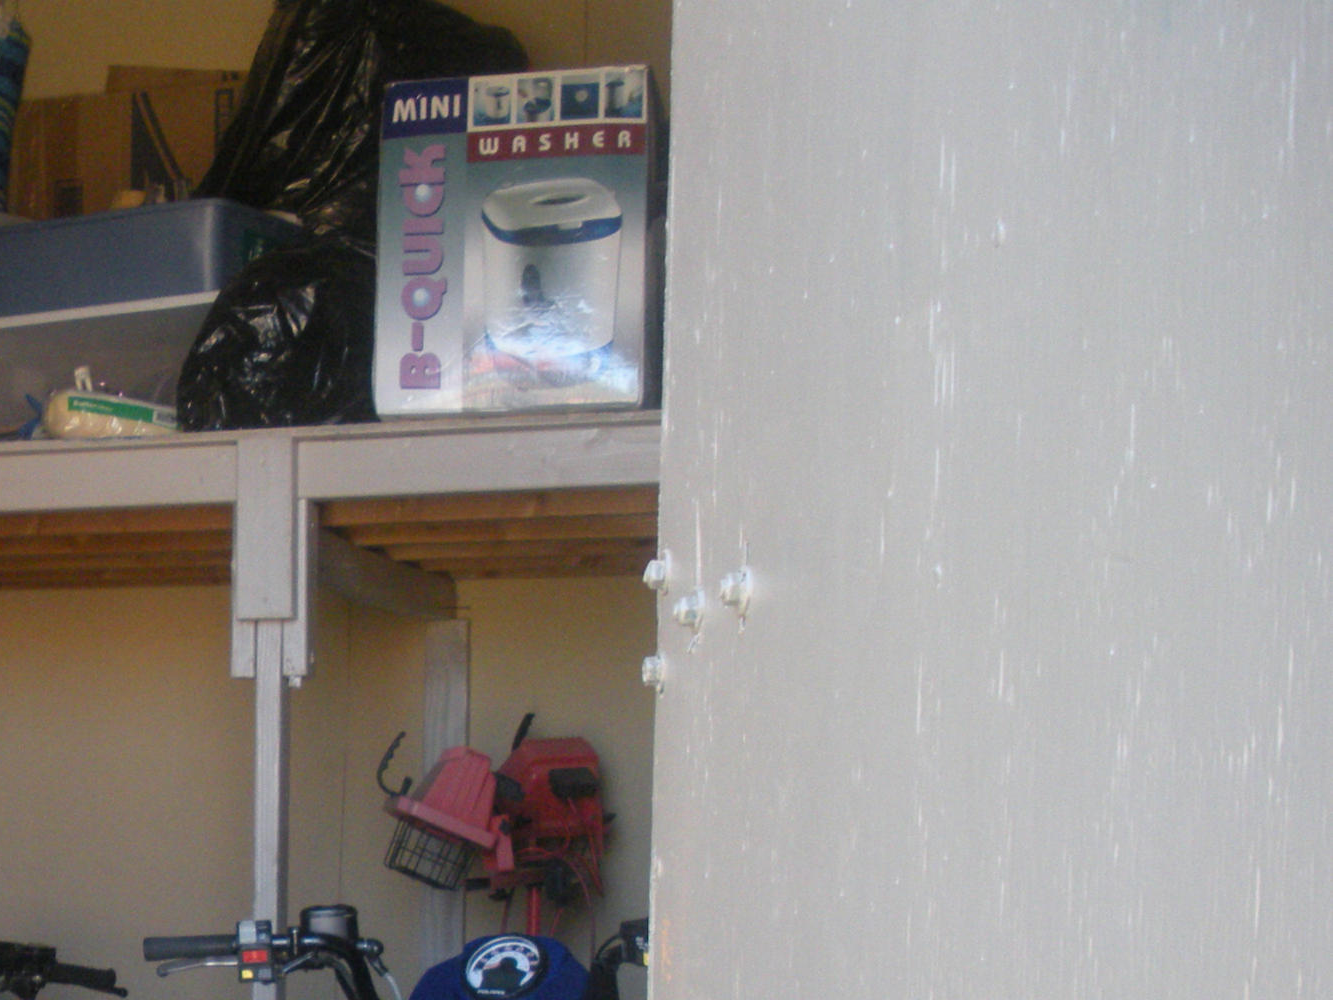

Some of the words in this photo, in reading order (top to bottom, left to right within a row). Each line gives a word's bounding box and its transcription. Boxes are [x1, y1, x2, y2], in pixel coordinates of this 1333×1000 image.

[391, 93, 462, 124] MINI
[478, 130, 632, 156] WASHER
[399, 144, 448, 390] B-QUICK
